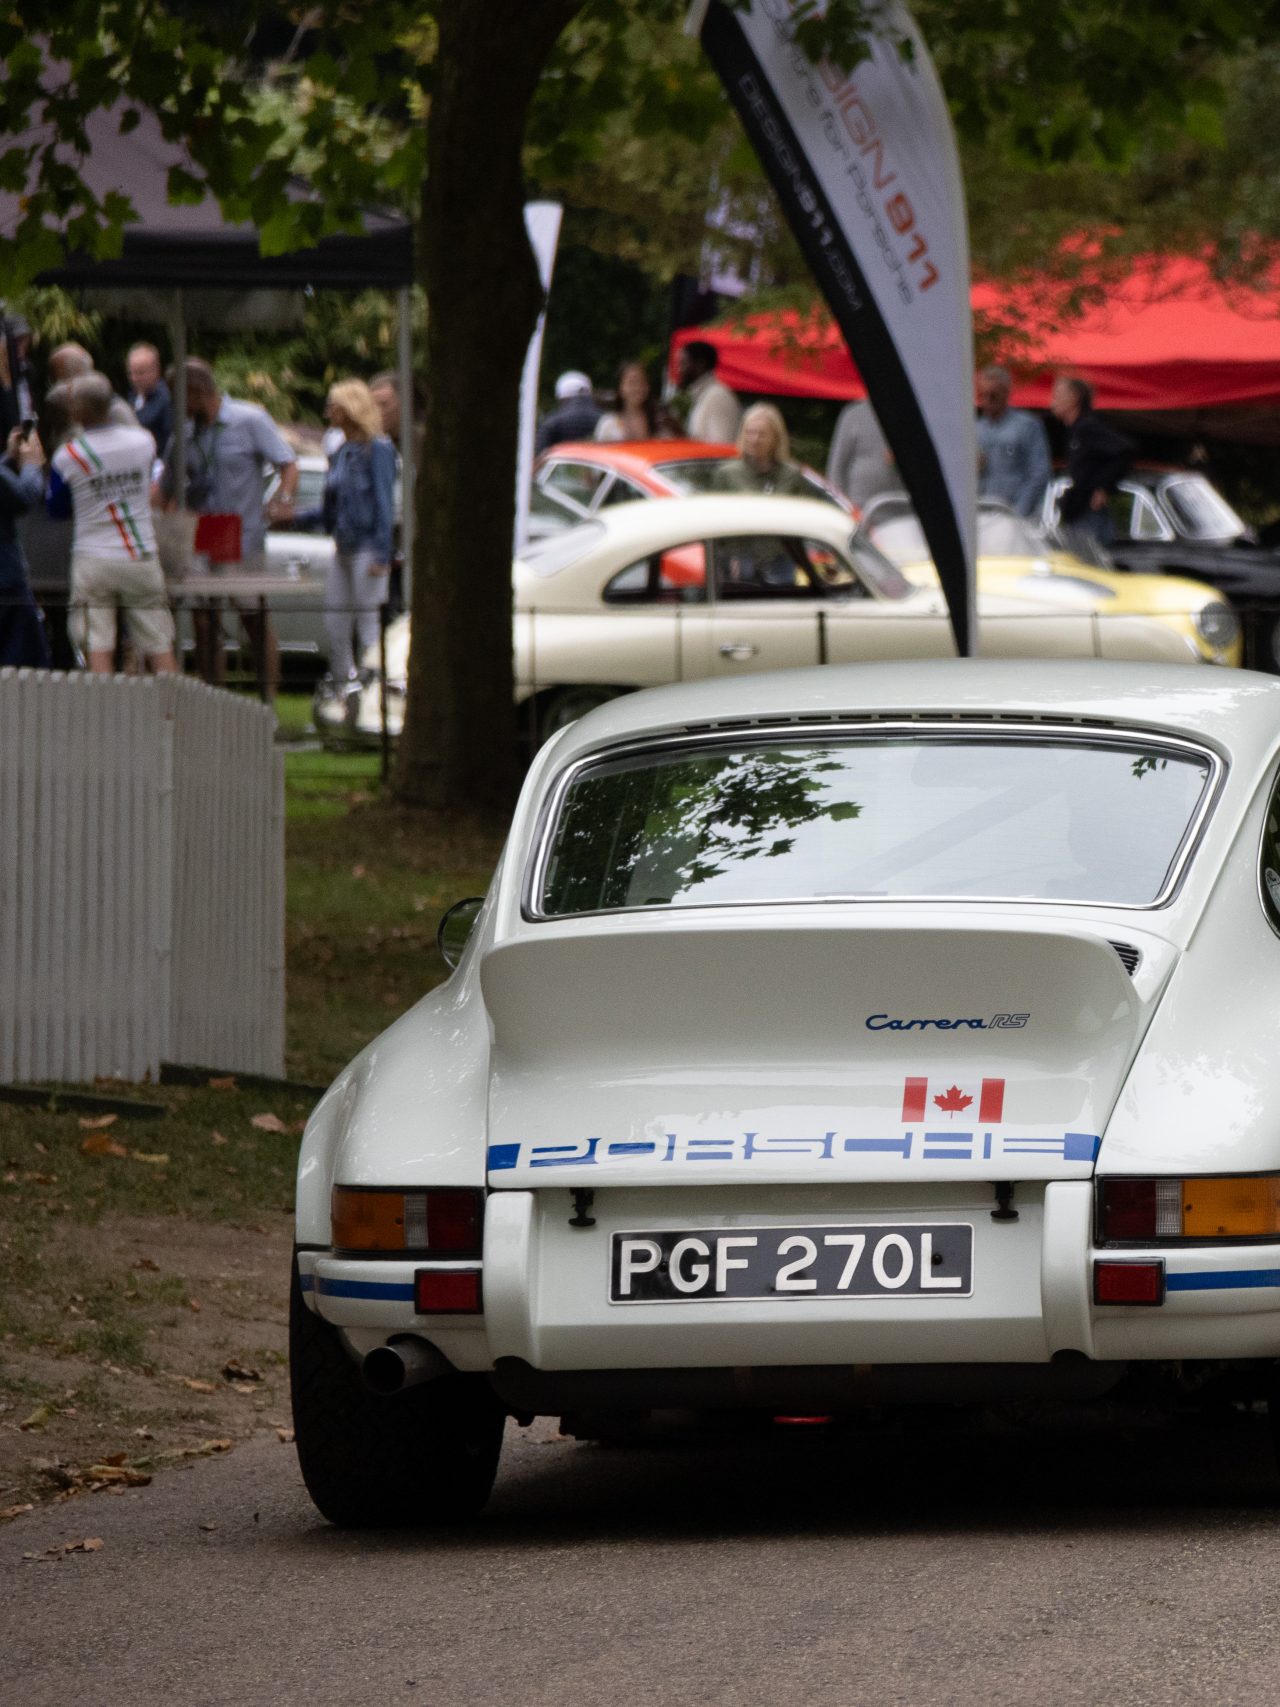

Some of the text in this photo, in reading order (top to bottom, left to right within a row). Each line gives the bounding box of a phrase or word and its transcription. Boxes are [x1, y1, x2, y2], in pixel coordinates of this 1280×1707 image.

[816, 109, 851, 161] for
[845, 161, 915, 306] Porsche
[885, 191, 941, 293] 911
[865, 1013, 1031, 1031] Carrera RS
[515, 1131, 1067, 1171] PORSCHE
[620, 1232, 962, 1295] PGF 270L
